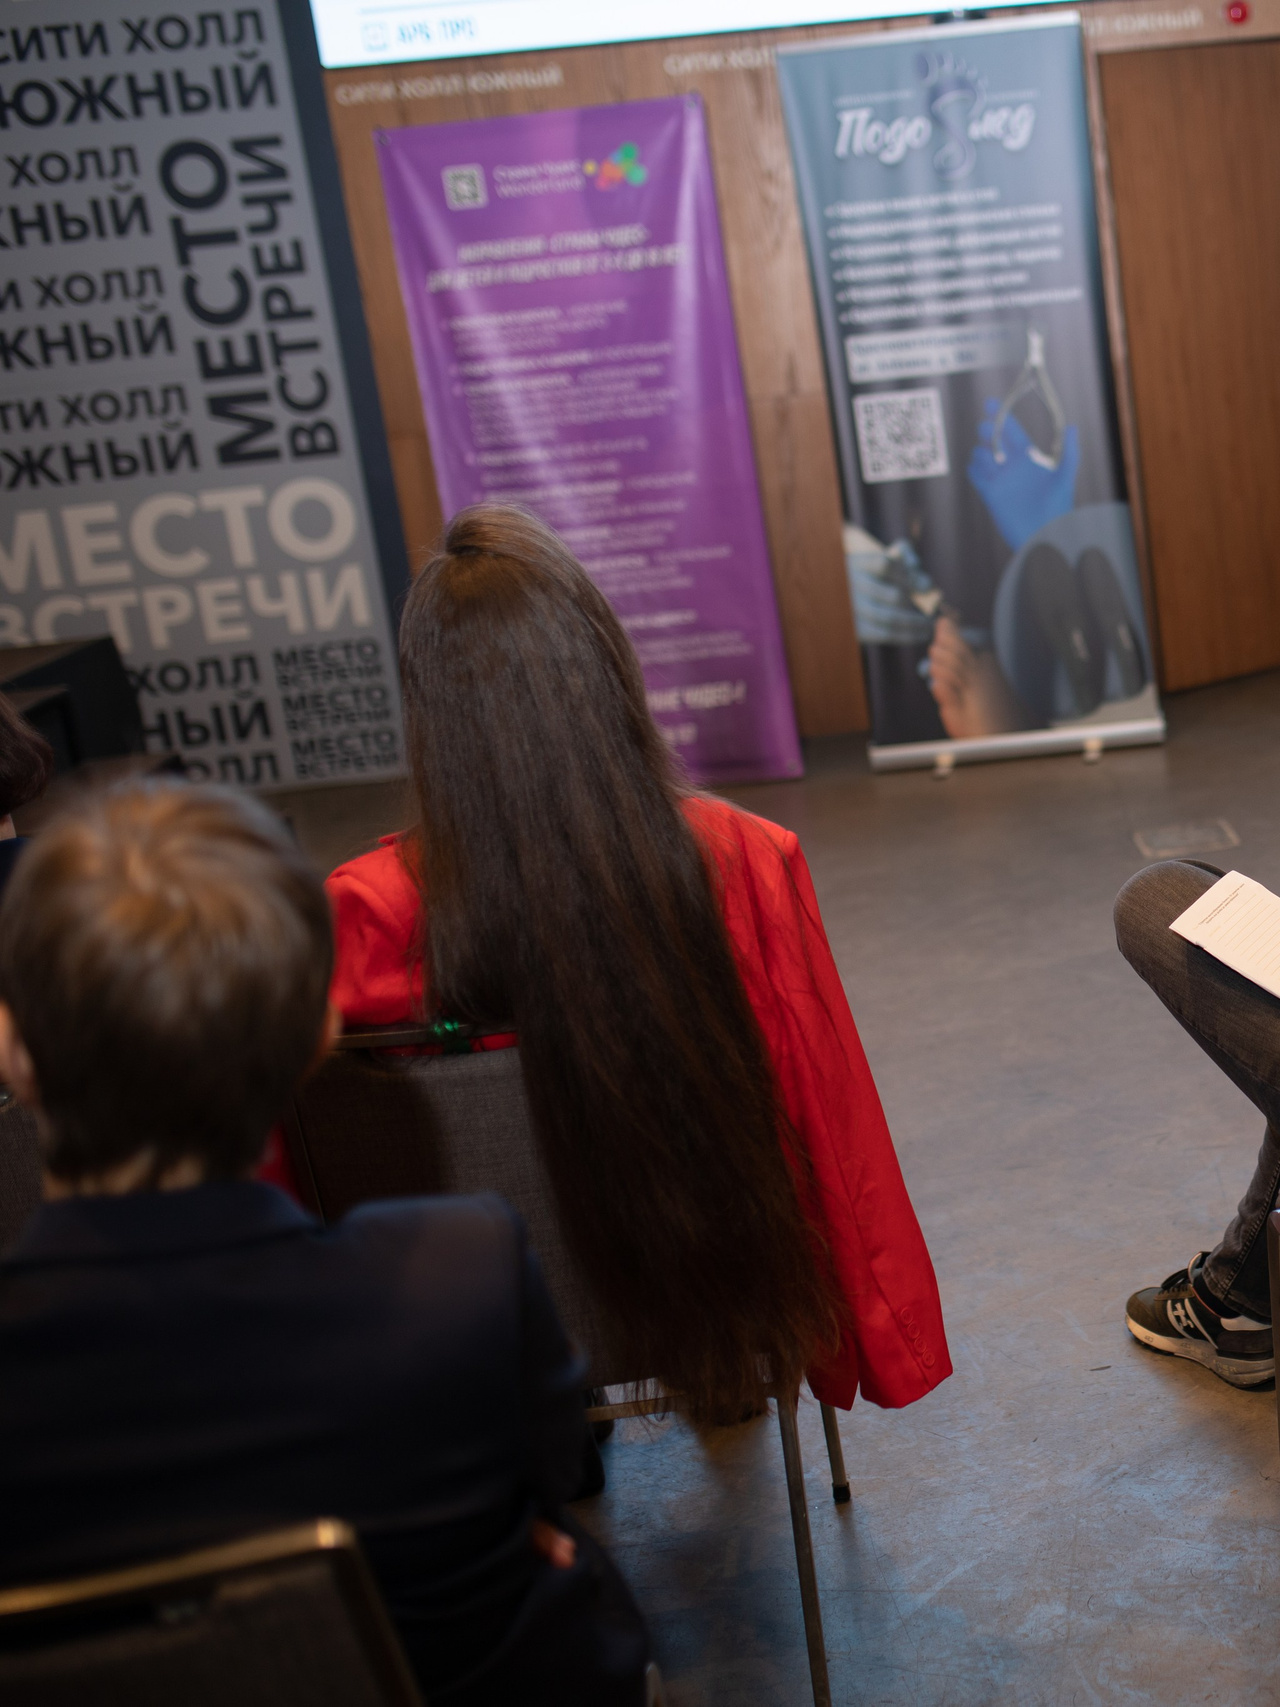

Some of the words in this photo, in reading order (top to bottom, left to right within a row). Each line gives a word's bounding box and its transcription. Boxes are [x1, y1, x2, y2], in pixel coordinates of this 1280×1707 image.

[0, 22, 109, 65] ИТИ
[121, 9, 265, 54] ХОЛЛ
[0, 48, 277, 130] ЮЖНЫЙ
[6, 145, 139, 189] ХОЛЛ
[0, 181, 153, 250] НЫЙ
[32, 266, 163, 311] ХОЛЛ
[159, 137, 283, 469] МЕСТО
[231, 134, 341, 459] ВСТРЕЧИ
[58, 383, 188, 427] ХОЛЛ
[0, 421, 200, 490] ЖНЫЙ
[0, 477, 357, 595] МЕСТО
[273, 637, 380, 669] МЕСТО
[282, 682, 389, 714] МЕСТО
[290, 727, 397, 759] МЕСТО
